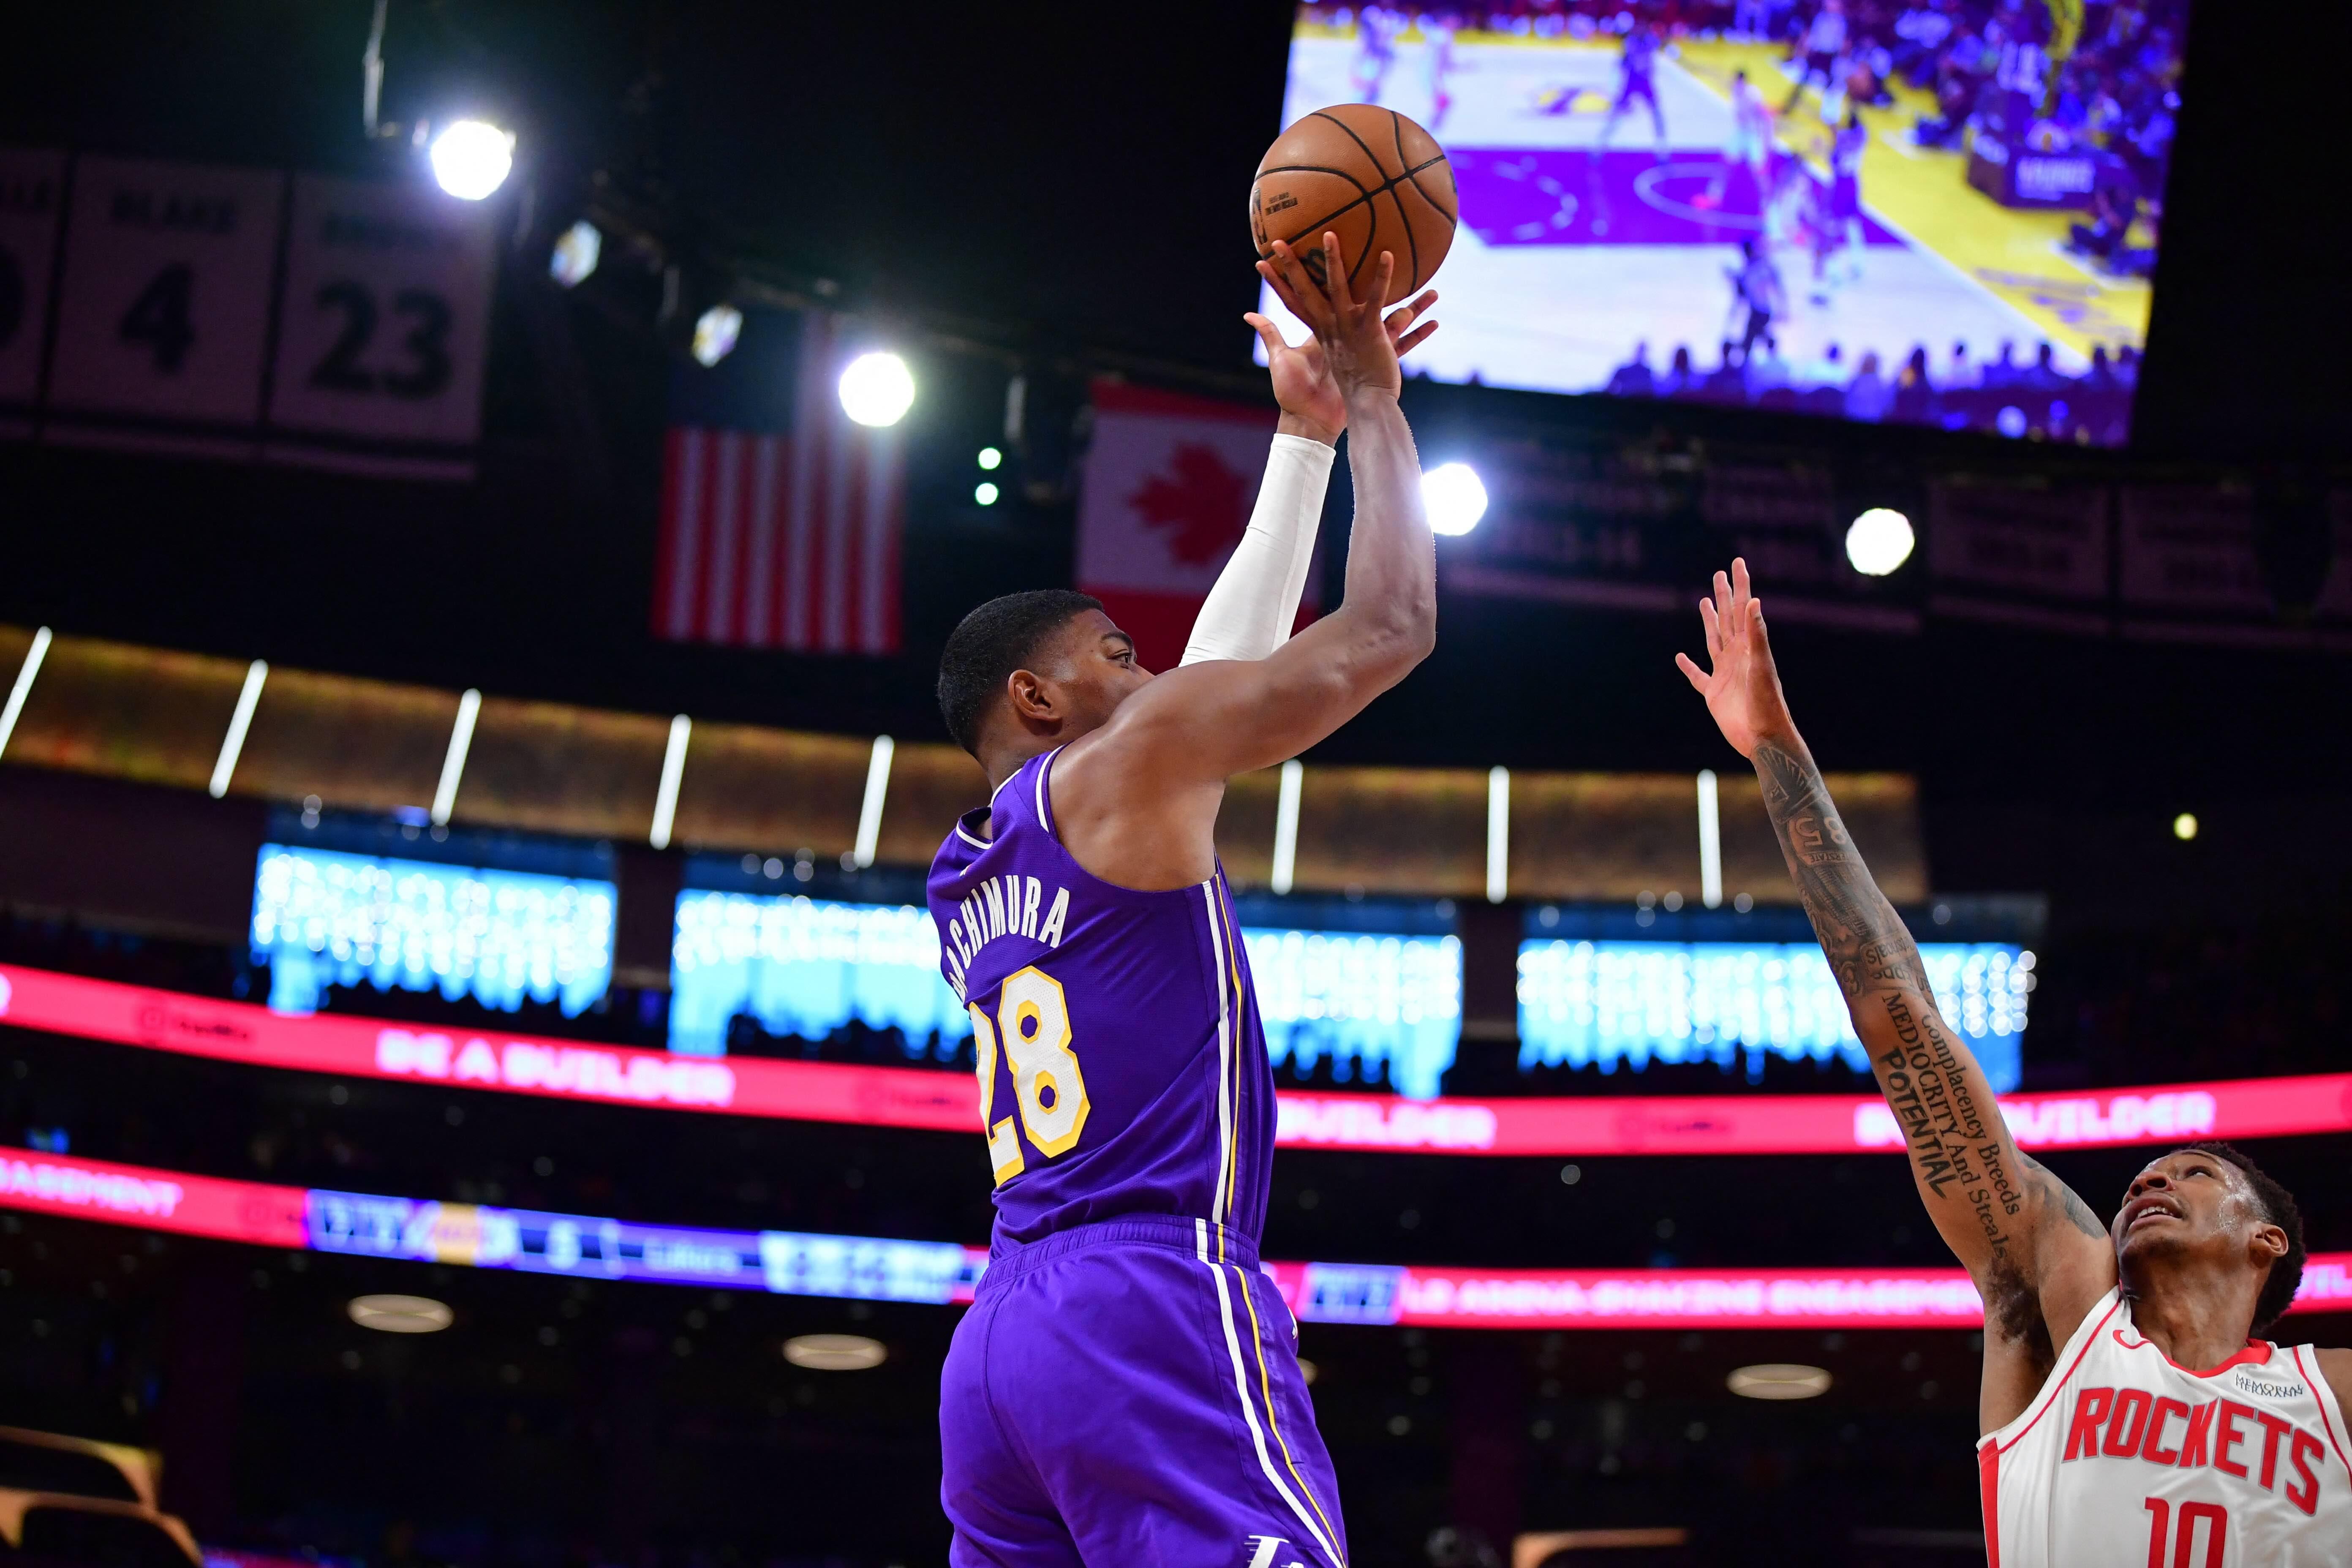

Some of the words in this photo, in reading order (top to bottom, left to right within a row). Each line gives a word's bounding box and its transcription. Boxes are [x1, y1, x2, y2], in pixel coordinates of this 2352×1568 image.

[118, 261, 197, 376] 4
[308, 280, 454, 400] 23
[376, 1028, 453, 1078] BE
[453, 1037, 499, 1084] A
[502, 1041, 736, 1108] BUILDER
[969, 965, 1091, 1189] 28
[1878, 1046, 1957, 1200] POTENTIAL
[1882, 992, 1963, 1136] MEDIOCRITY
[1947, 1145, 1981, 1186] And
[1968, 1188, 2006, 1260] Steals
[1922, 1015, 1987, 1141] Complacency
[1977, 1142, 2022, 1216] Breeds
[2235, 1372, 2303, 1394] MEMORIAL
[2062, 1387, 2325, 1517] ROCKETS
[2144, 1496, 2228, 1568] 10
